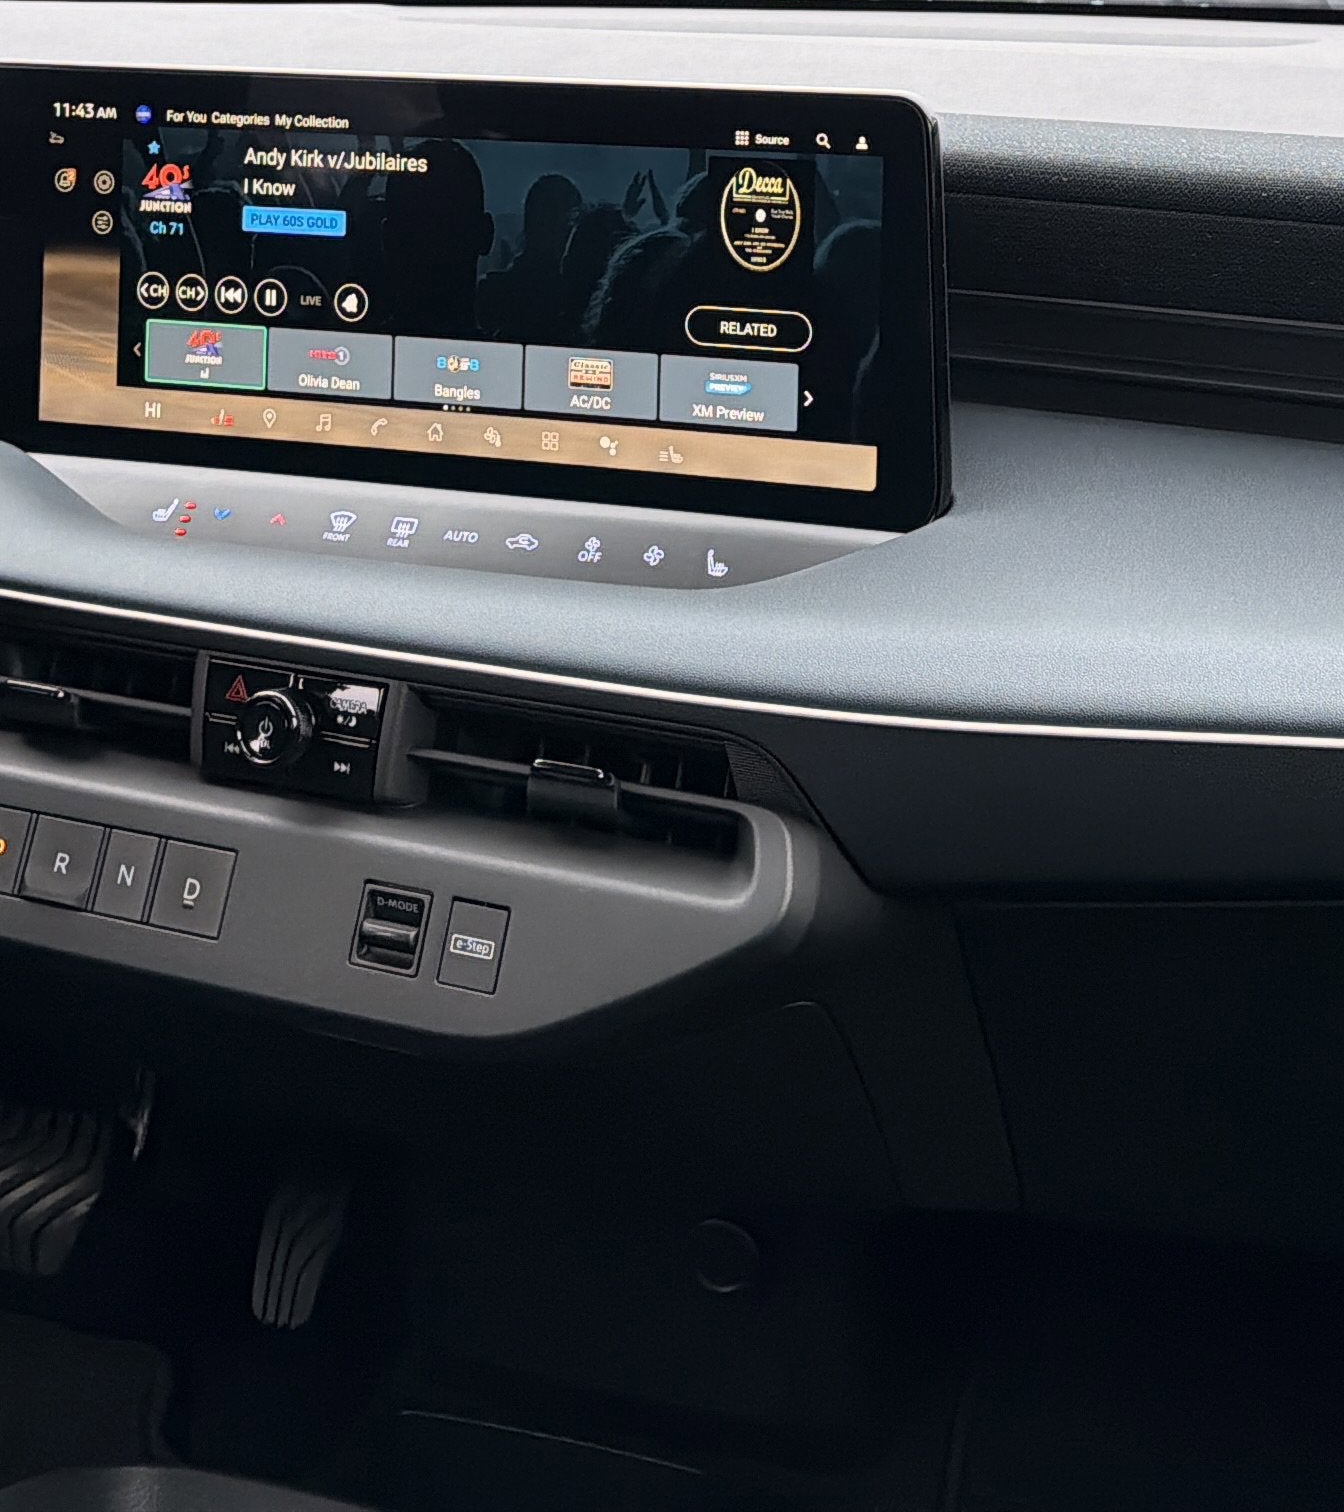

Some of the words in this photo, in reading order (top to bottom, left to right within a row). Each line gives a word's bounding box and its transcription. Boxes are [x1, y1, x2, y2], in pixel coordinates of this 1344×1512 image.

[53, 102, 94, 119] 11:43
[96, 106, 117, 120] AM
[167, 109, 184, 123] For
[186, 110, 207, 124] You
[211, 111, 270, 127] Categories
[275, 113, 292, 129] My
[294, 114, 349, 128] Collection
[754, 134, 790, 146] Source
[244, 147, 286, 170] Andy
[291, 148, 324, 168] Kirk
[327, 151, 428, 172] v/Jubilaires
[243, 178, 248, 194] I
[253, 178, 296, 196] Know
[738, 167, 784, 194] Decca
[139, 199, 192, 213] JUNCTION
[149, 221, 167, 235] Ch
[169, 222, 184, 235] 71
[251, 213, 279, 226] PLAY
[282, 214, 304, 227] 60S
[307, 215, 338, 229] GOLD
[300, 294, 322, 306] LIVE
[719, 320, 777, 337] RELATED
[298, 373, 329, 388] Olivia
[331, 375, 360, 390] Dean
[572, 374, 610, 383] REWIND
[434, 384, 481, 402] Bangles
[570, 395, 611, 410] AC/DC
[692, 403, 714, 418] XM
[716, 405, 765, 422] Preview
[322, 532, 351, 542] FRONT
[386, 538, 410, 548] REAR
[443, 530, 479, 544] AUTO
[577, 550, 603, 563] OFF
[329, 697, 368, 715] CAMERA
[53, 852, 70, 875] R
[116, 864, 135, 887] N
[183, 877, 201, 901] D
[376, 896, 419, 914] D-MODE
[455, 938, 490, 955] e-Step
